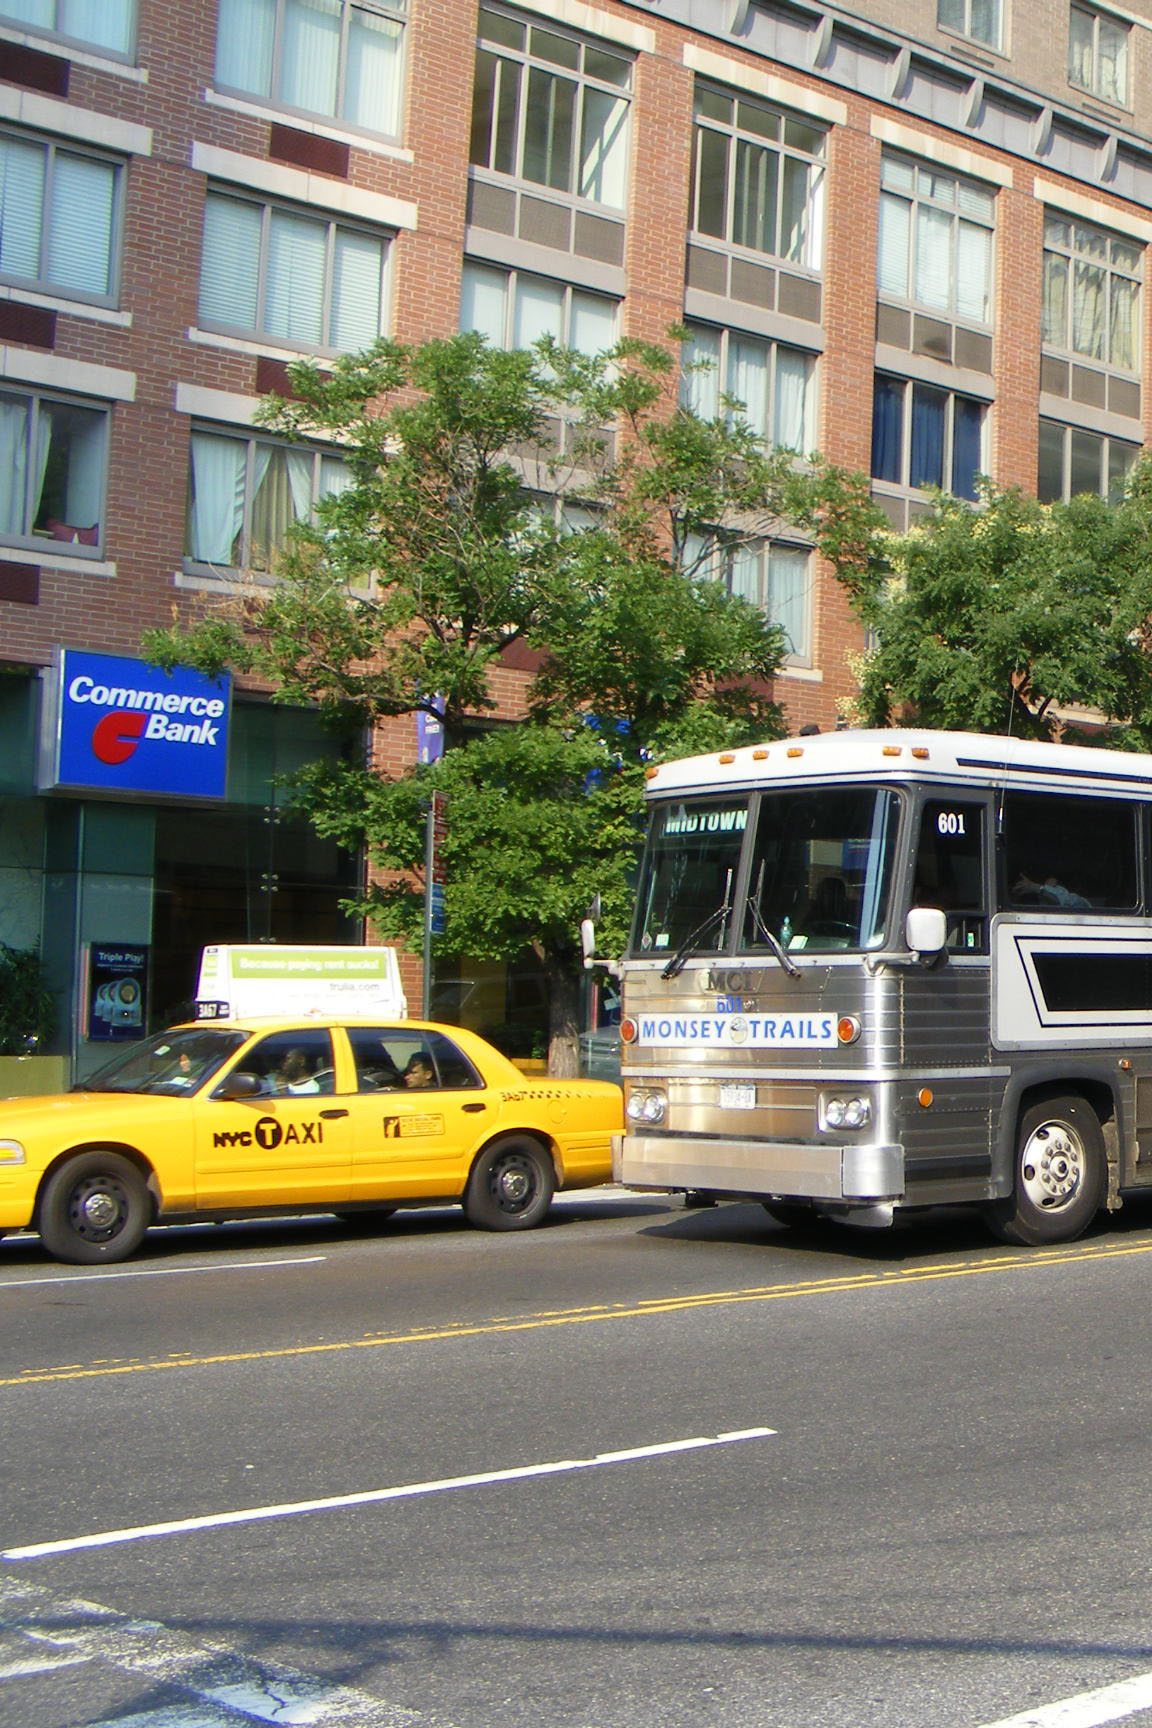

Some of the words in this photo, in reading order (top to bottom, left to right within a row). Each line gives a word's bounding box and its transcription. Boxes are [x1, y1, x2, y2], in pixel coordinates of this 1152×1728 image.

[69, 676, 225, 718] Commerce
[144, 714, 220, 746] Bank
[666, 810, 748, 833] MIDTOWN
[938, 812, 966, 834] 601
[98, 952, 124, 962] Triple
[124, 953, 144, 964] Play!
[239, 957, 287, 969] Because
[288, 958, 322, 971] paying
[323, 957, 345, 969] rent
[346, 957, 379, 970] sucks!
[717, 994, 743, 1013] 601
[642, 1020, 727, 1039] MONSEY
[750, 1020, 832, 1039] TRAILS
[213, 1130, 253, 1148] NYC
[255, 1116, 323, 1150] TAXI
